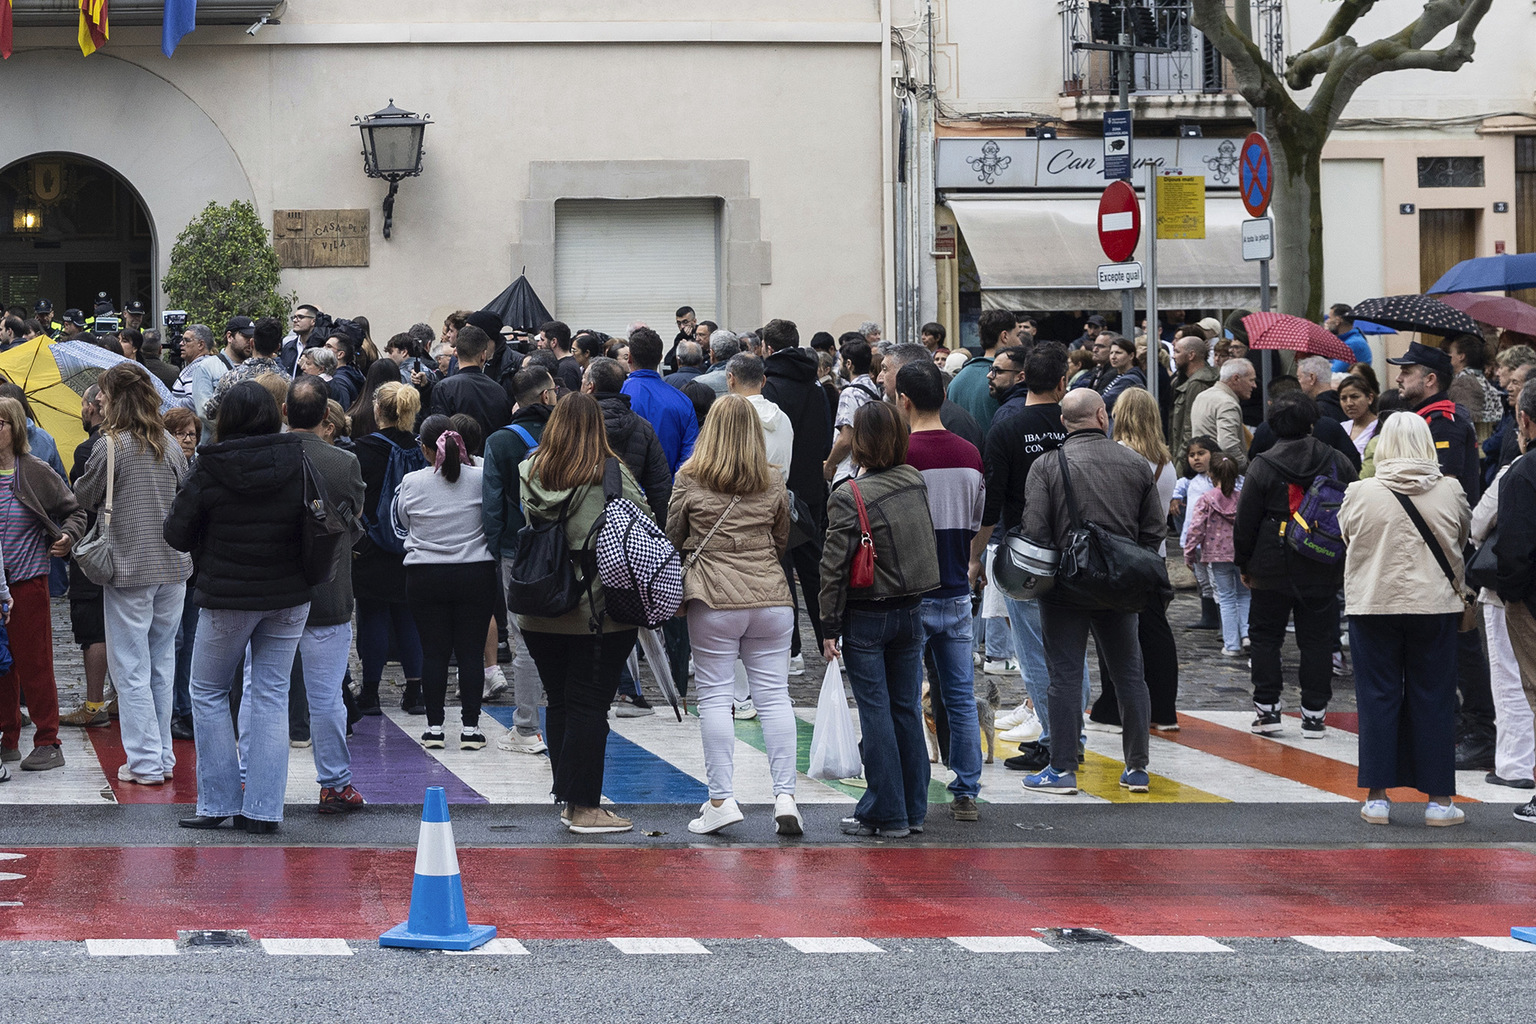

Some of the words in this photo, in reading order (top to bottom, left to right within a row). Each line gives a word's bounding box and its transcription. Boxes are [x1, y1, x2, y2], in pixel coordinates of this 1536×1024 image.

[1047, 149, 1097, 174] Can
[315, 222, 341, 236] CASA
[348, 223, 356, 232] DE
[322, 239, 346, 251] VILA
[1100, 271, 1124, 283] Excepte
[1126, 270, 1140, 283] gual
[1304, 537, 1335, 557] Longinus
